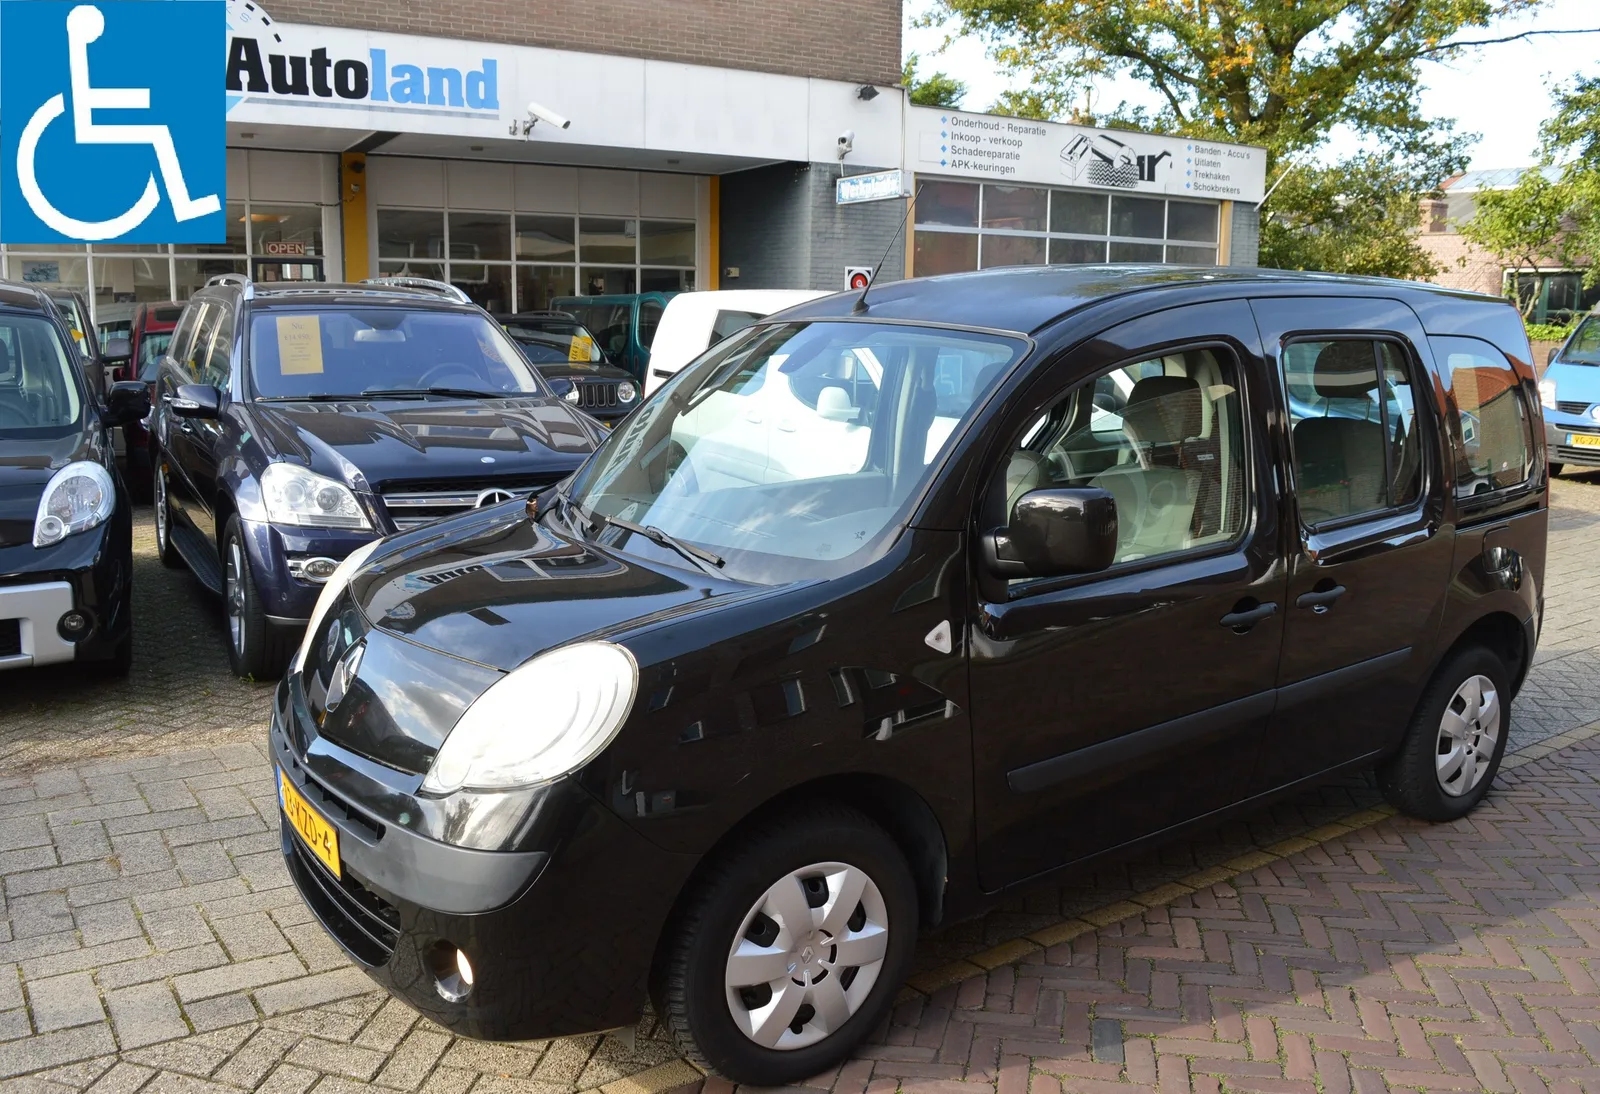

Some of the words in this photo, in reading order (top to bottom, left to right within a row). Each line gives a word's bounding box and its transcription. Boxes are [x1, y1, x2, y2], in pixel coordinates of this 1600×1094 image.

[226, 36, 499, 111] Autoland
[951, 116, 1000, 131] Onderhoud
[1007, 123, 1047, 136] Reparatie
[951, 131, 981, 144] Inkoop
[988, 136, 1023, 148] verkoop
[951, 145, 1020, 161] Schadereparatie
[1194, 145, 1222, 156] Banden
[1227, 149, 1251, 160] Accu's
[951, 159, 1016, 175] APK-keuringen
[1194, 157, 1221, 168] Uitlaten
[1194, 169, 1231, 181] Trekhaken
[1193, 182, 1241, 195] Schokbrekers
[268, 243, 305, 254] OPEN
